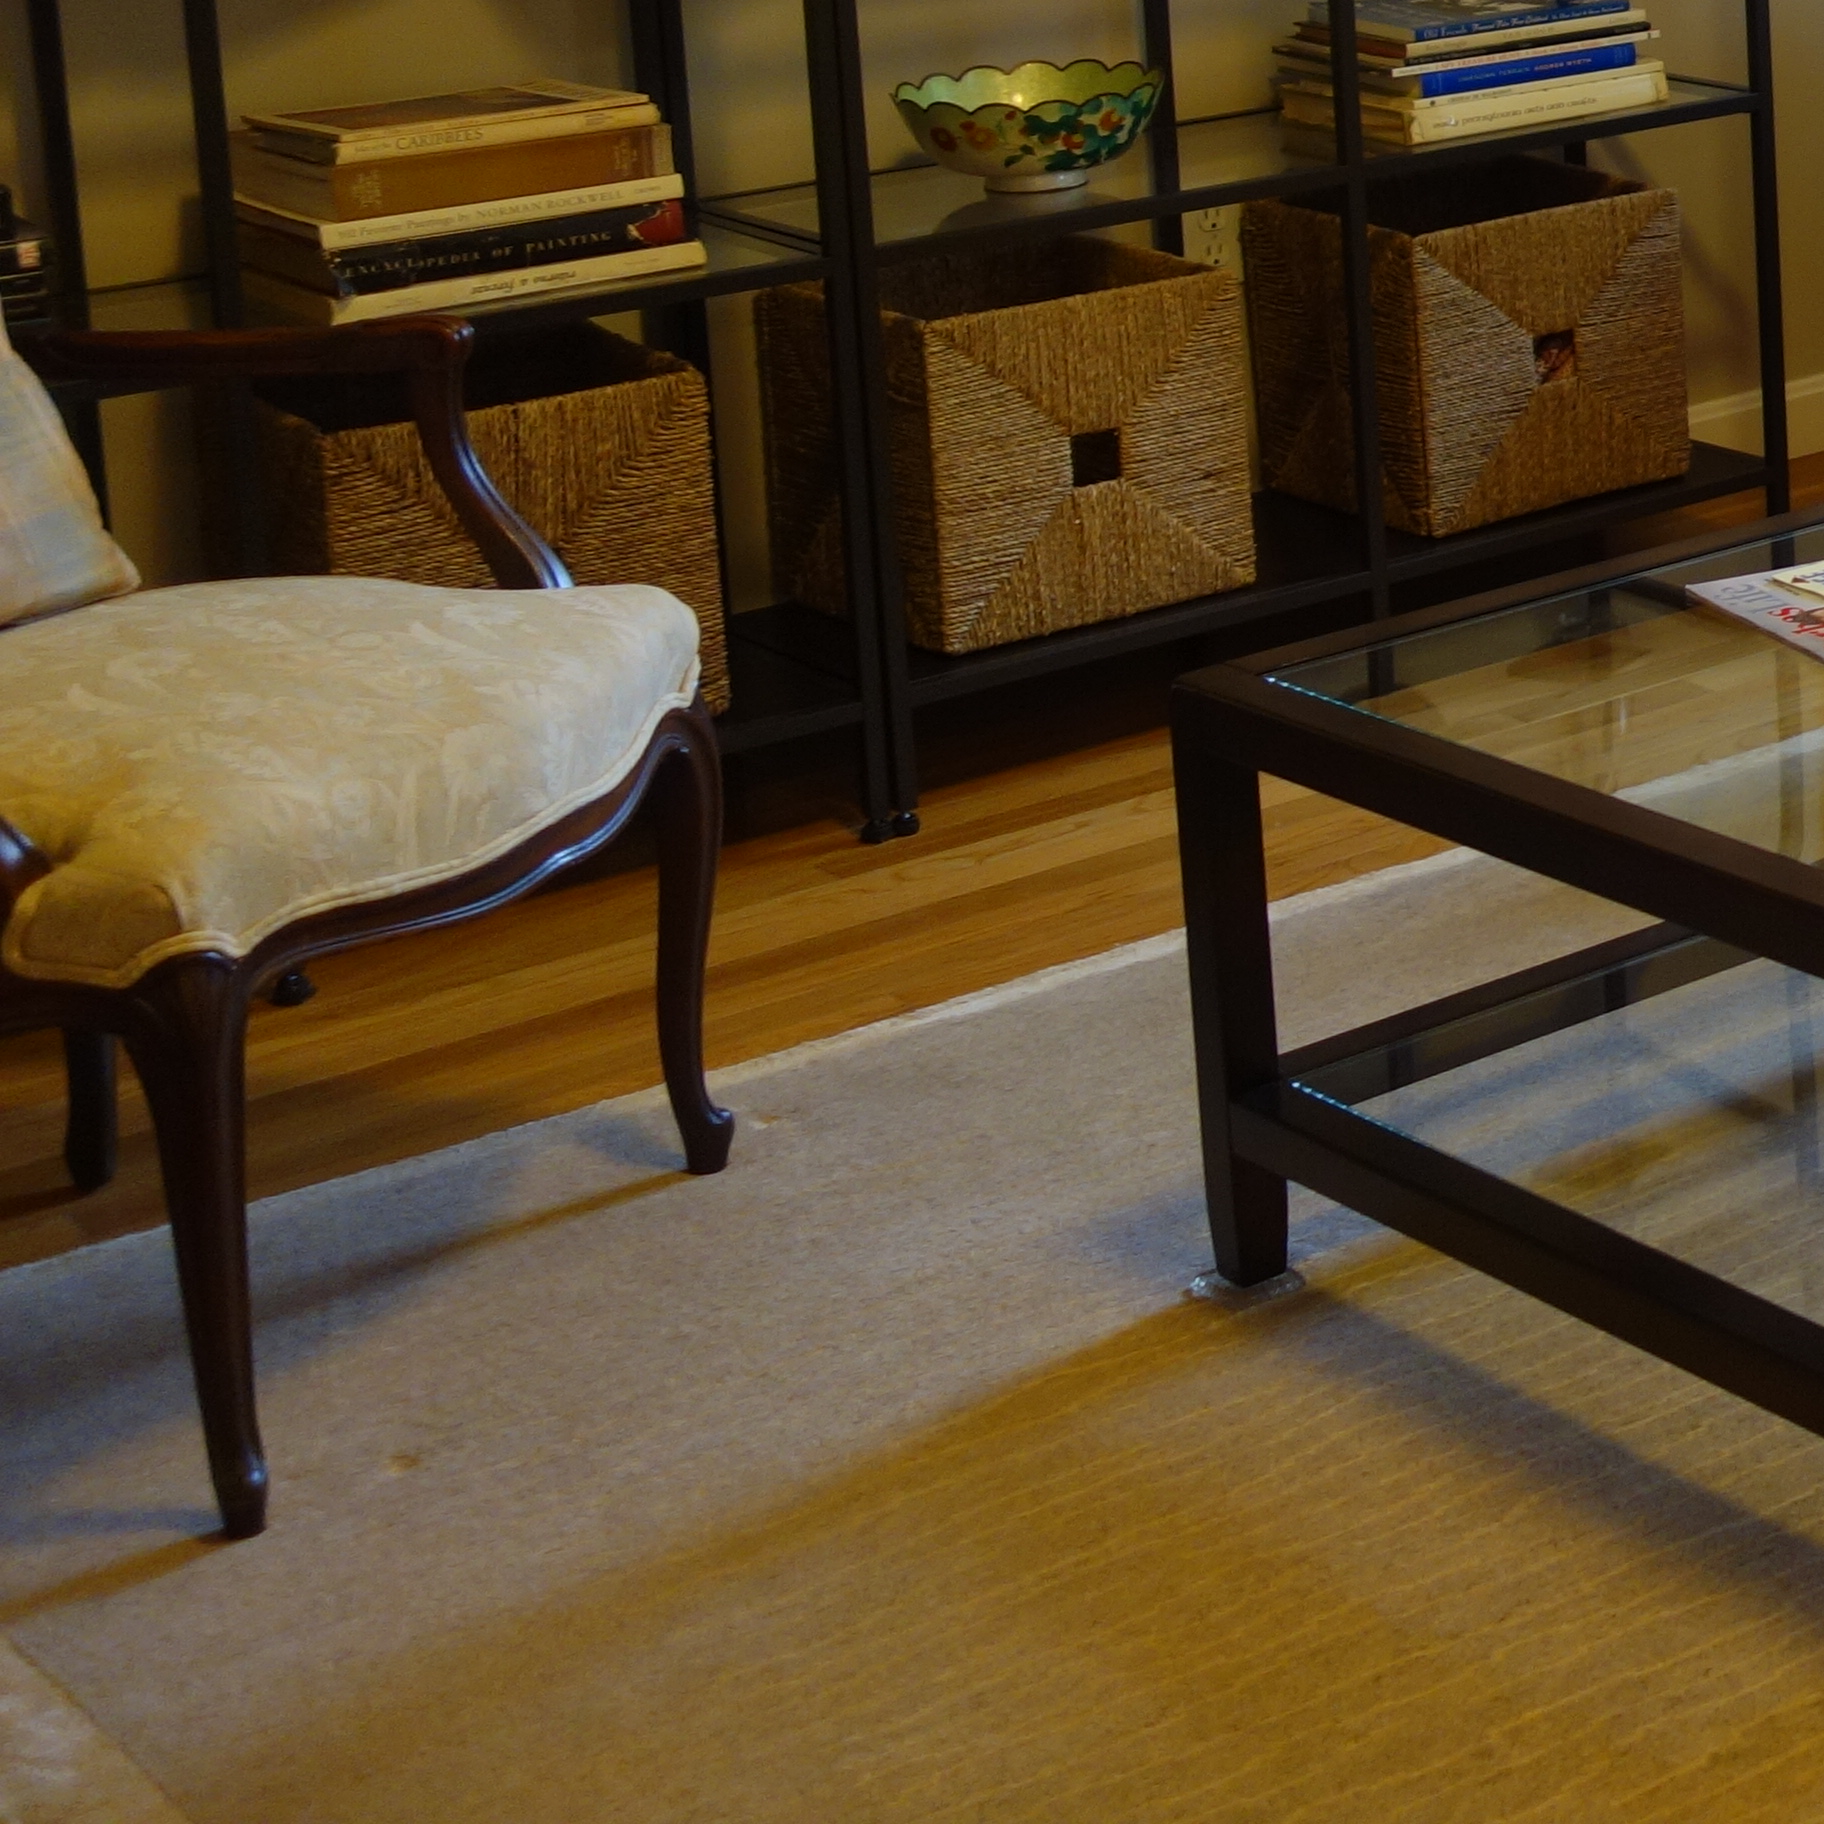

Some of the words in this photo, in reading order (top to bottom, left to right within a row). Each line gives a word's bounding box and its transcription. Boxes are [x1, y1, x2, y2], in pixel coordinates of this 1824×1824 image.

[476, 202, 543, 221] NORMAN
[547, 189, 625, 210] ROCKWELL
[491, 245, 514, 260] OF
[525, 231, 614, 254] PAINTING
